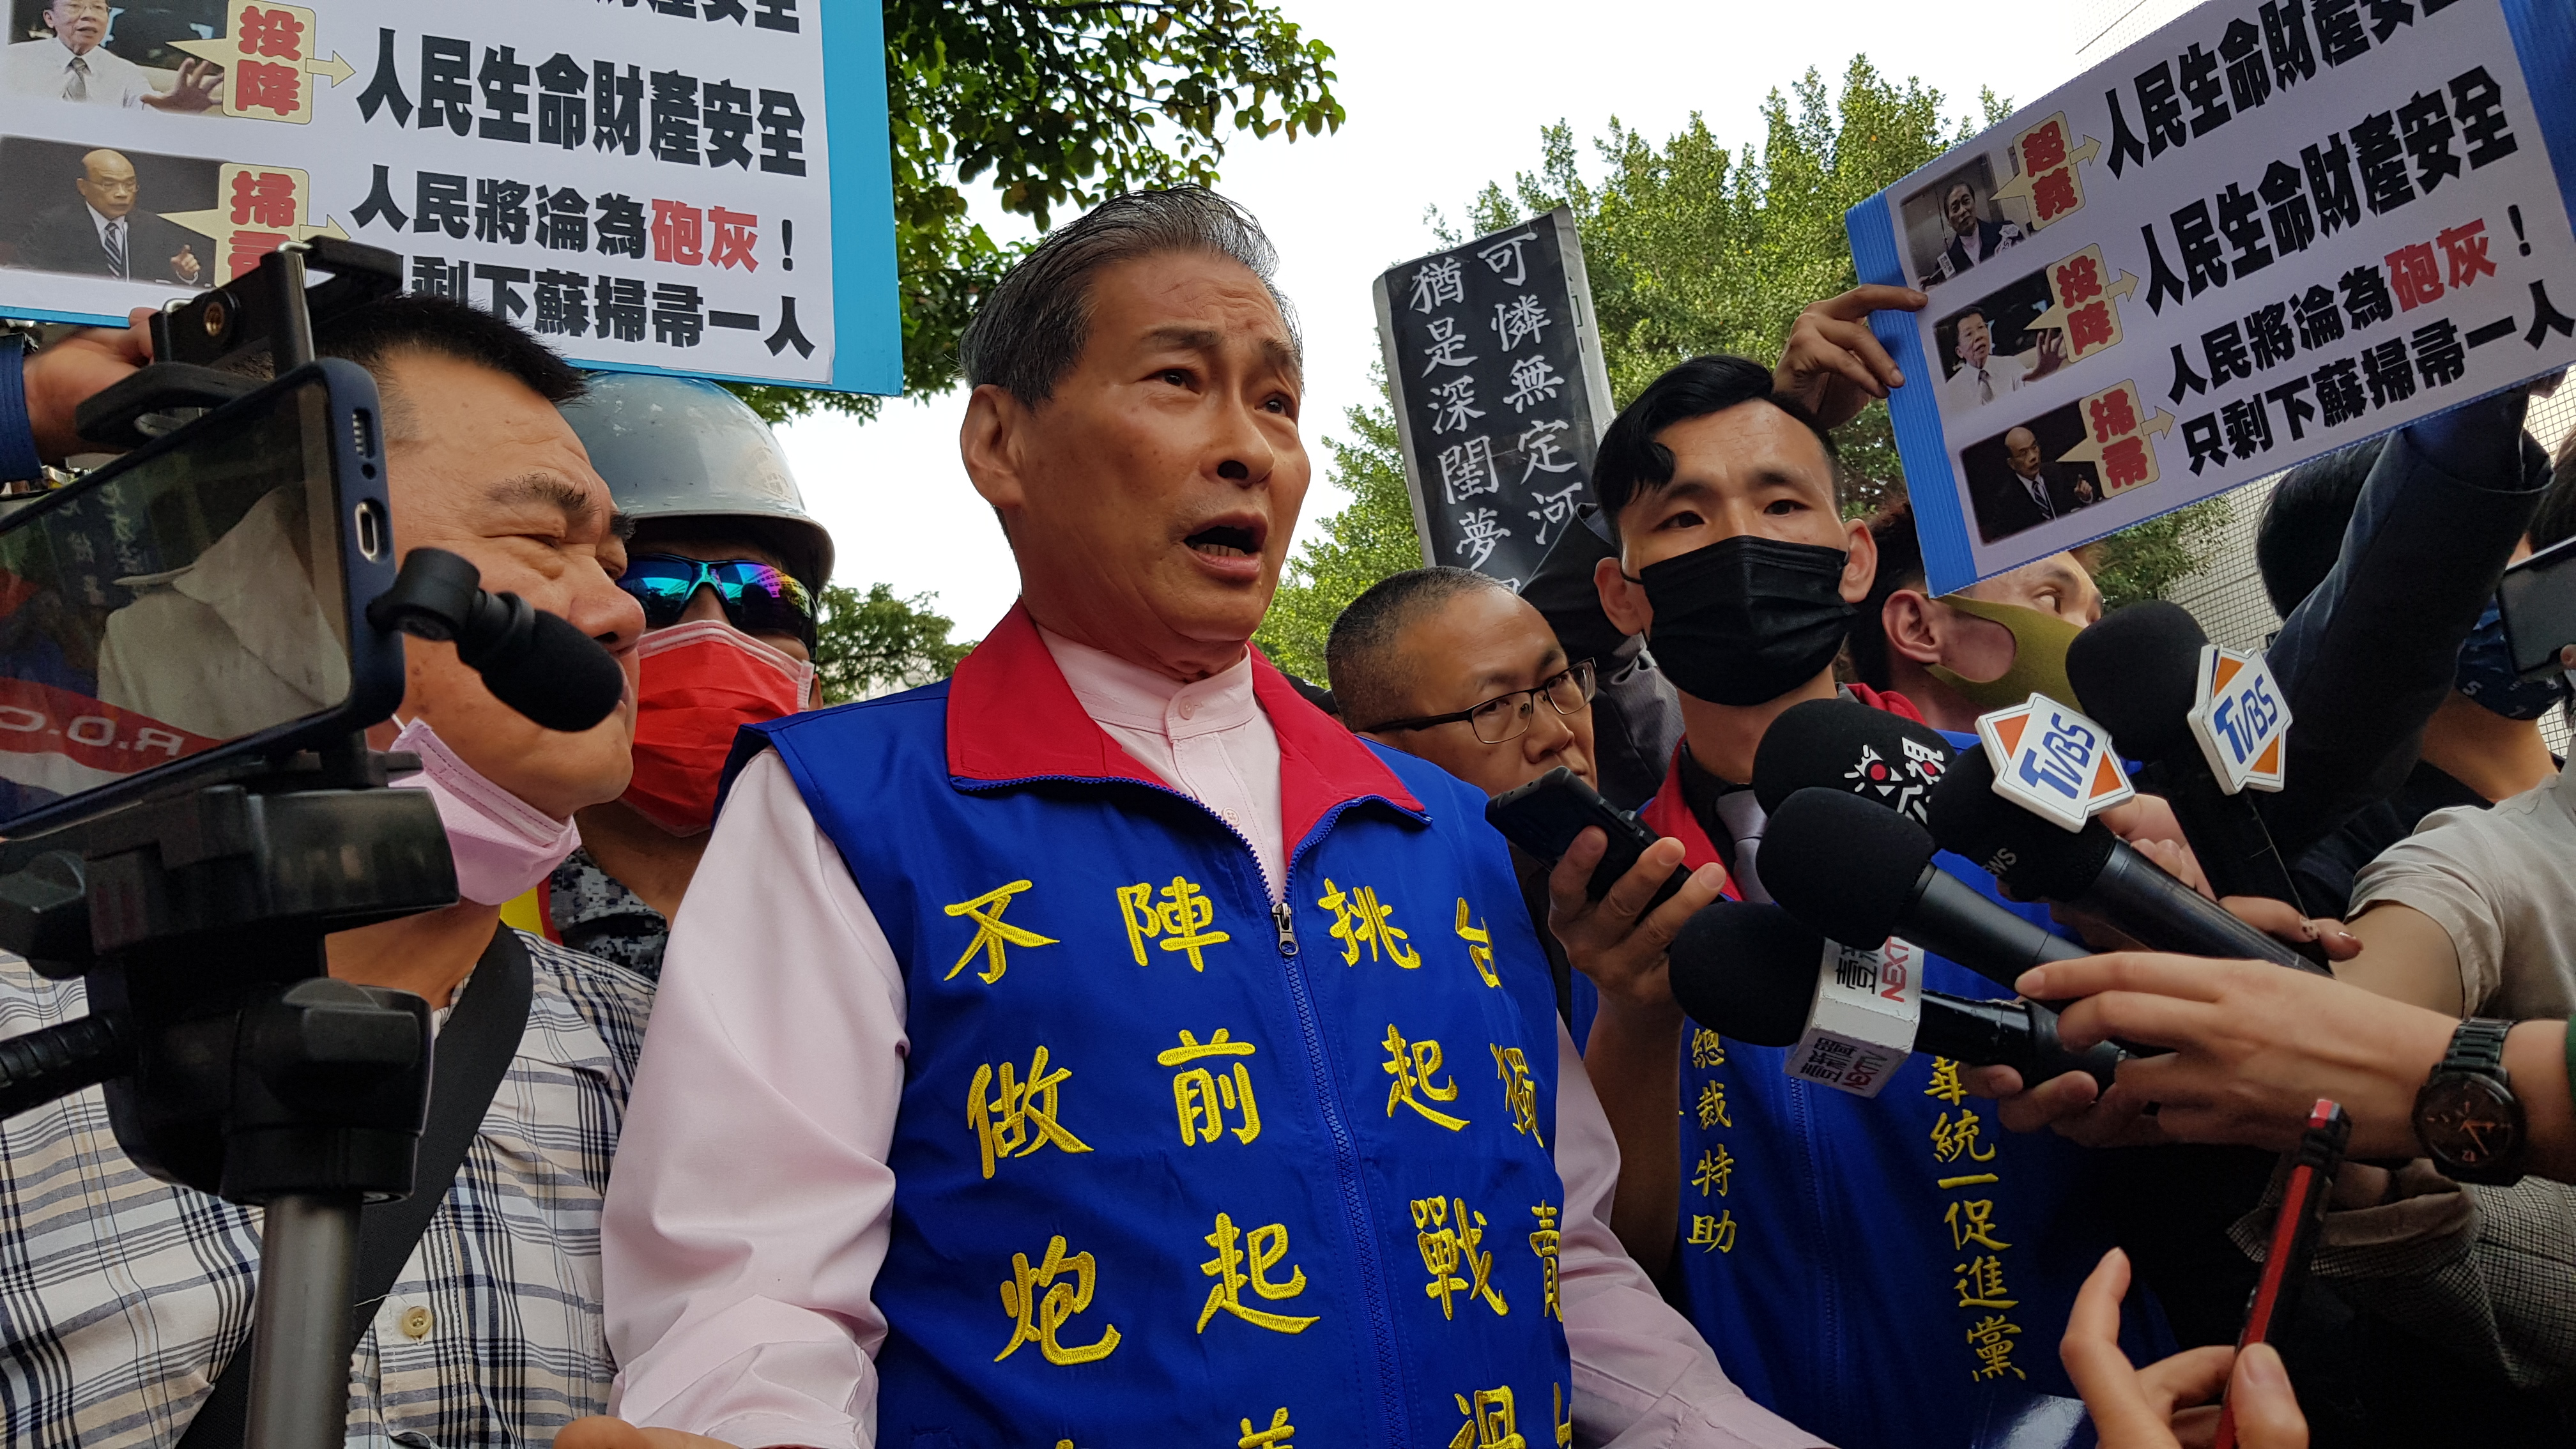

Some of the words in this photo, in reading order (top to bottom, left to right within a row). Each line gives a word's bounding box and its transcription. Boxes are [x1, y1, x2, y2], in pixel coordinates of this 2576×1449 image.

[236, 5, 303, 116] 投降
[356, 27, 806, 177] 人民生命財產安全
[2105, 0, 2458, 180] 人民生命財產
[2140, 65, 2518, 318] 人民生命財產安全
[1478, 231, 1584, 546] 可憐無定河
[2056, 255, 2113, 356] 投降
[2181, 279, 2575, 477] 只剩下蘇掃帚一人
[1409, 256, 1521, 594] 猶是深閨夢
[2089, 387, 2148, 489] 掃帚
[2018, 712, 2096, 800] TVBS
[2214, 673, 2278, 765] TVBS
[1982, 848, 2017, 878] WS
[1880, 935, 1910, 1003] NEXT
[944, 878, 1123, 1449] 不做炮
[1116, 875, 1321, 1449] 陣前起
[1456, 896, 1572, 1449] 台獨賣
[1687, 1027, 1737, 1254] 總裁特助
